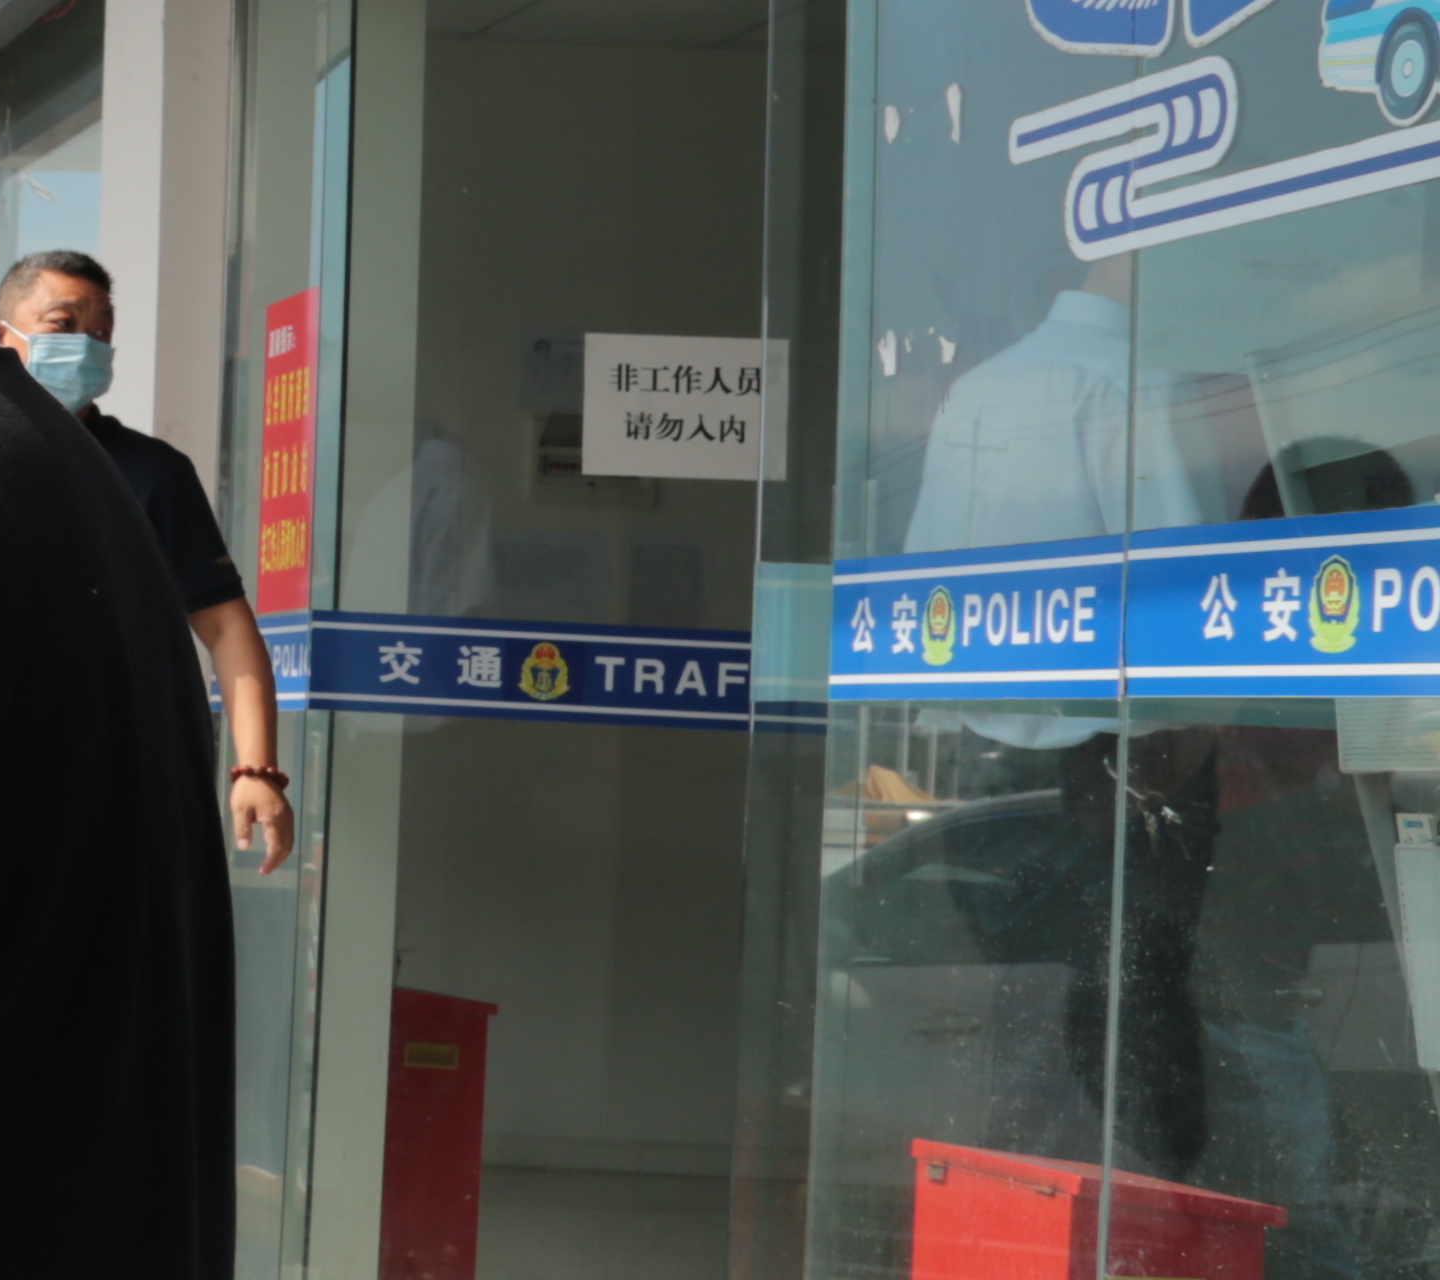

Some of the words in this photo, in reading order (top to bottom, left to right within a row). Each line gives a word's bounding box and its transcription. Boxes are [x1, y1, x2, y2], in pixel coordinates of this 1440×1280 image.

[608, 362, 763, 397] 非工作人员
[623, 410, 747, 446] 请勿入内
[849, 591, 918, 656] 公安
[961, 585, 1098, 648] POLICE
[1199, 564, 1303, 644] 公安
[1371, 564, 1440, 634] PO
[378, 640, 503, 688] 交通
[594, 655, 750, 698] TRAF
